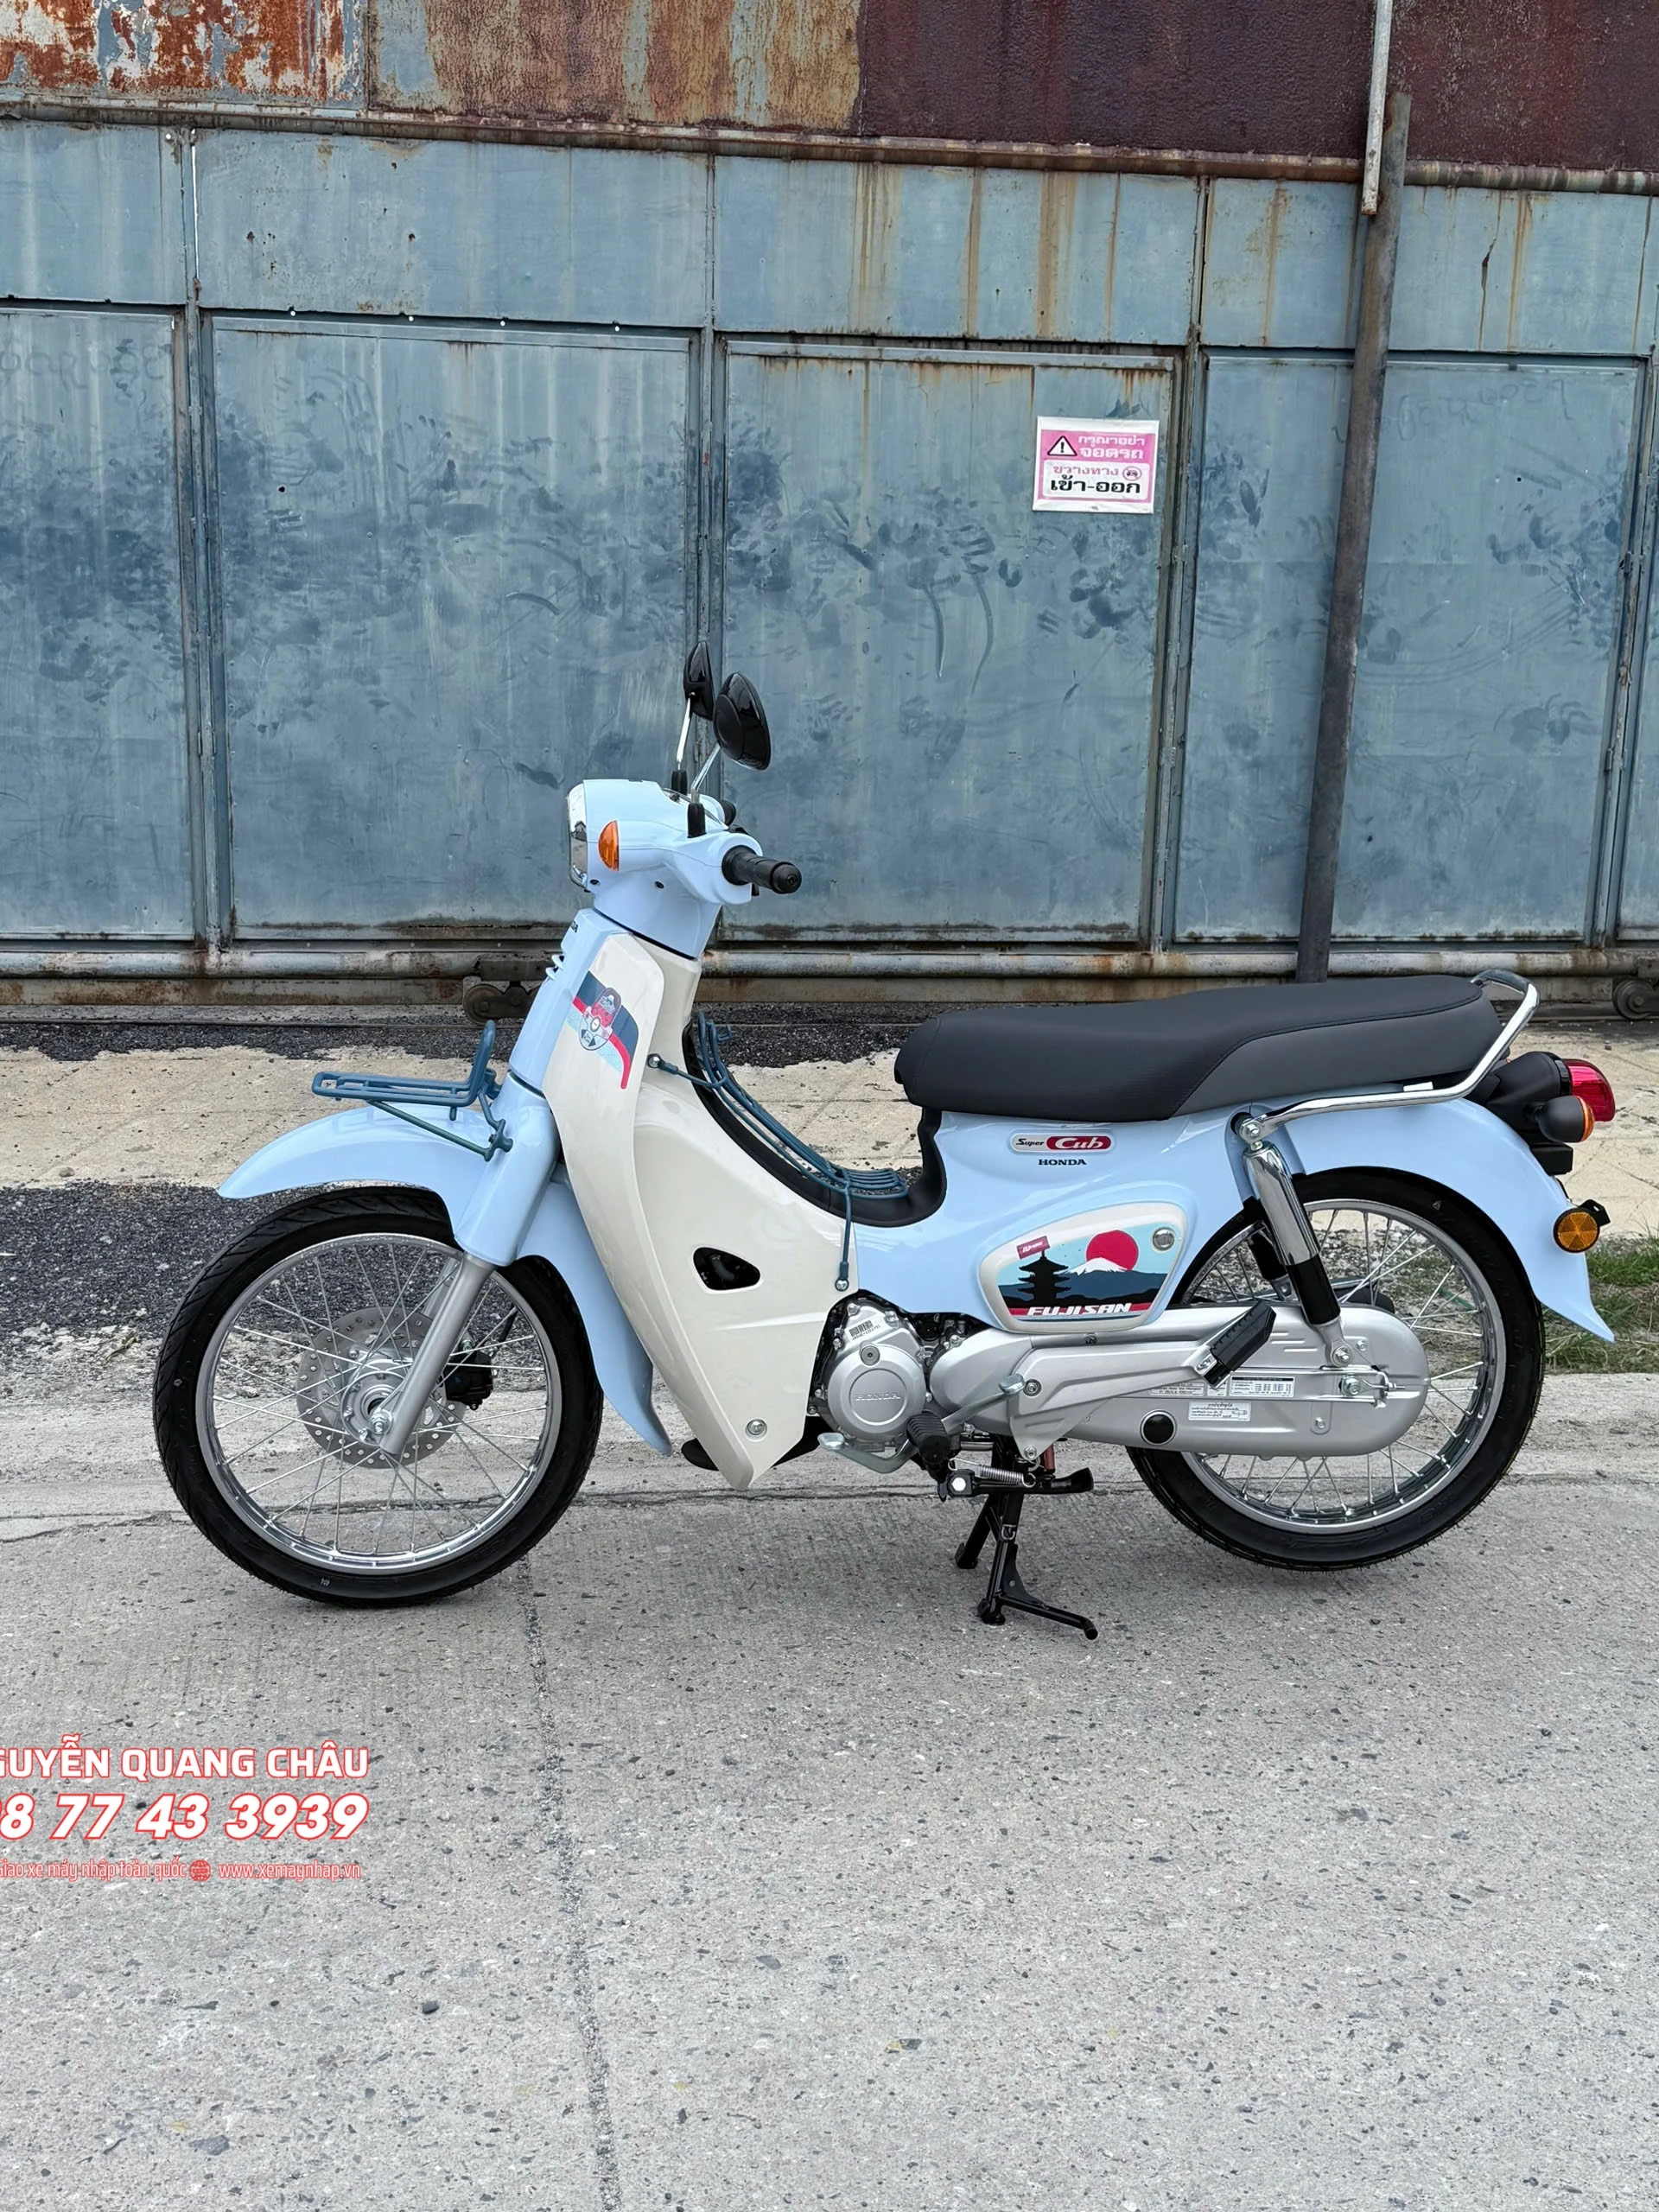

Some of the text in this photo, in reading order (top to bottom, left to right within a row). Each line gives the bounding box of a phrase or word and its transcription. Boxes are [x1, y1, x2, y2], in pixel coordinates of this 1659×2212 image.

[1080, 448, 1144, 460] จอดรถ
[1052, 466, 1119, 476] ขวางทาง
[1051, 474, 1141, 493] เข้า-ออก
[1016, 1137, 1103, 1149] Super Cub
[1027, 1303, 1132, 1316] FUJISAN
